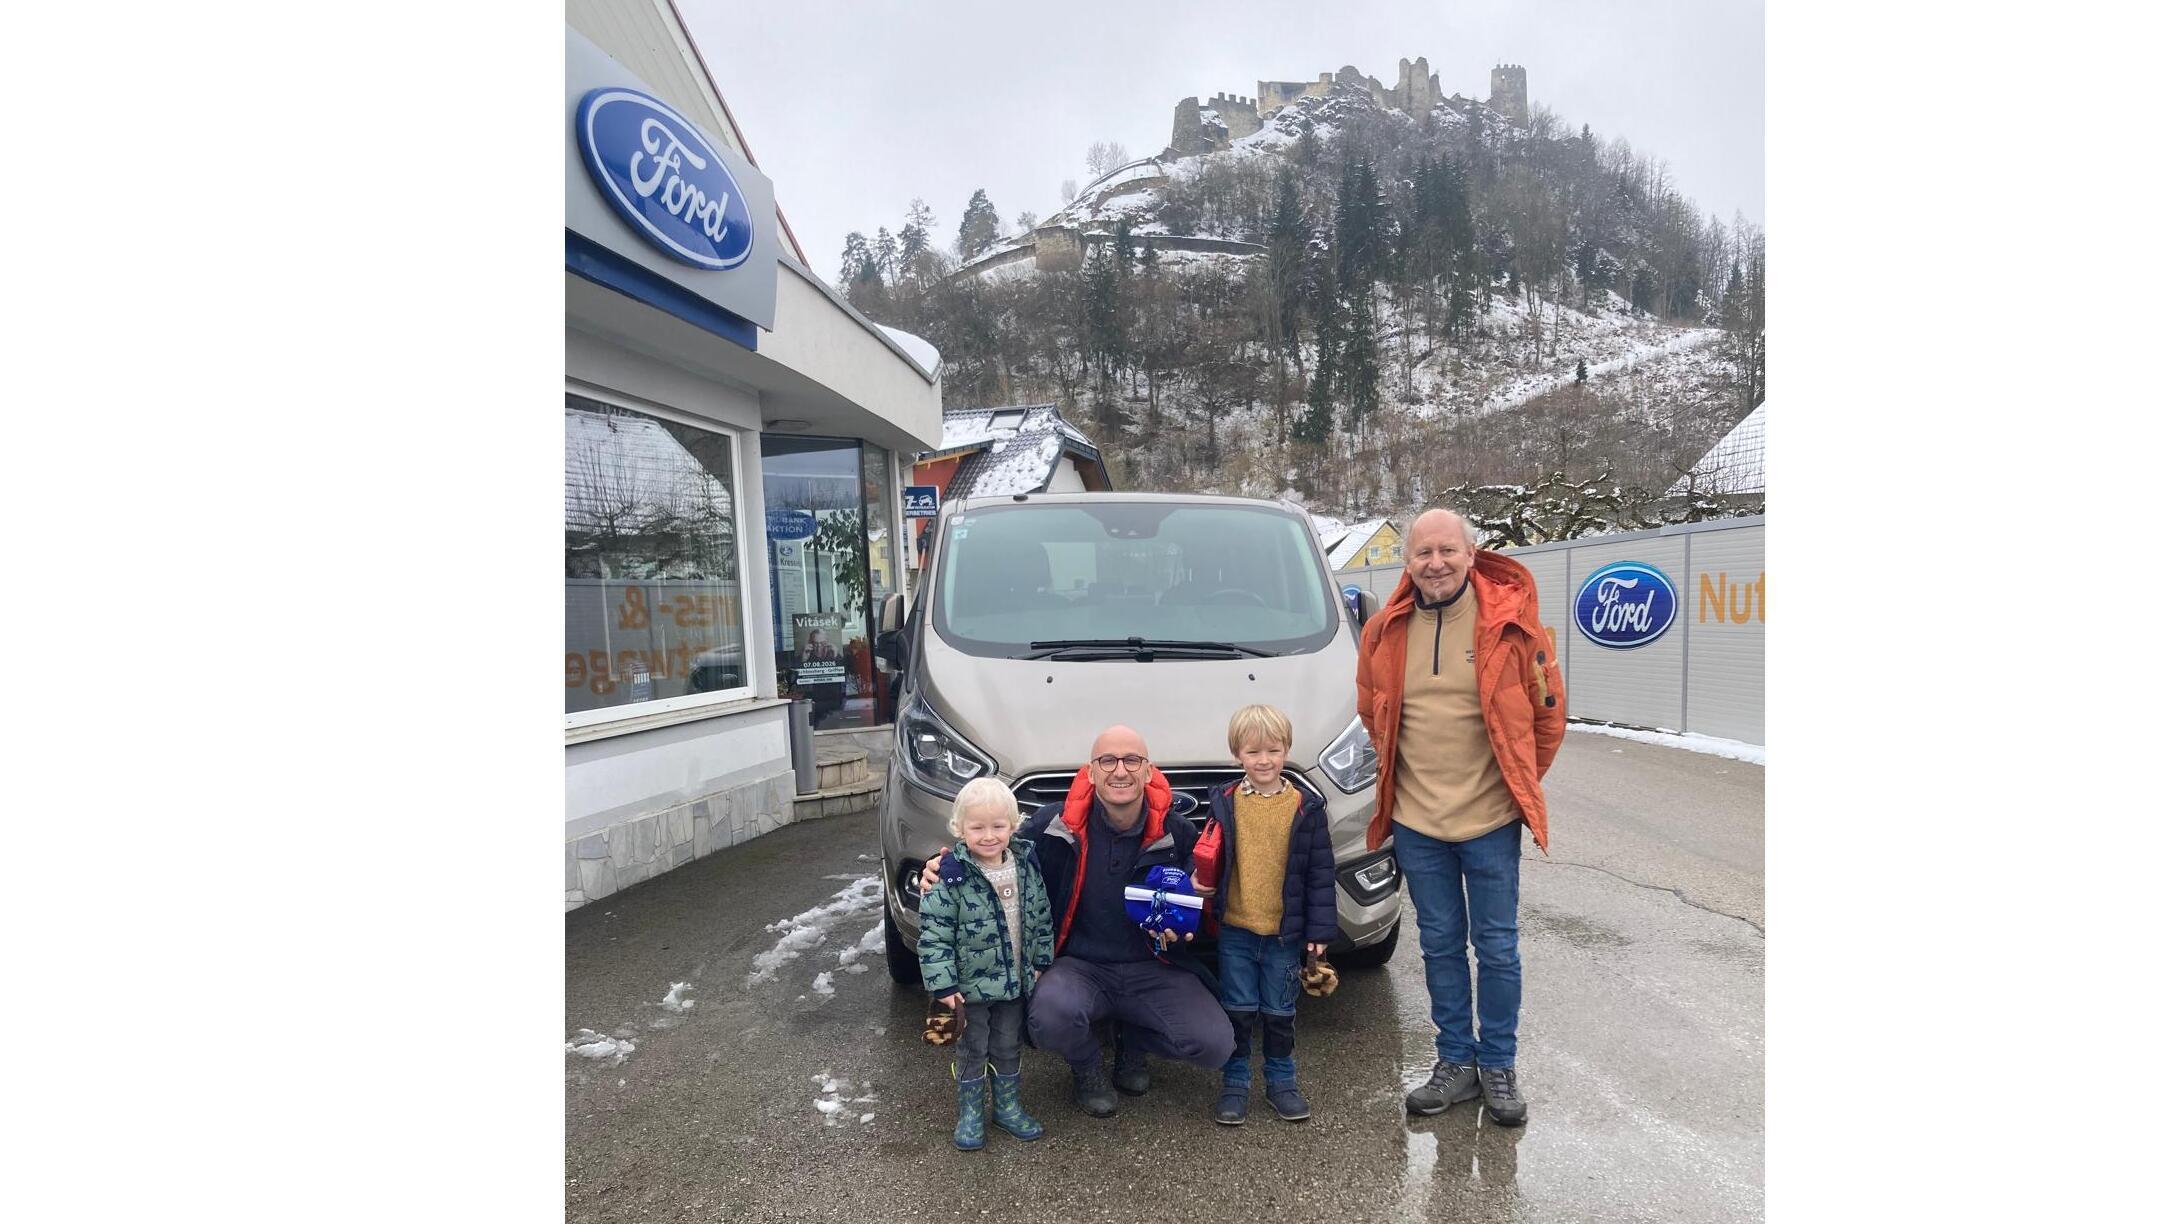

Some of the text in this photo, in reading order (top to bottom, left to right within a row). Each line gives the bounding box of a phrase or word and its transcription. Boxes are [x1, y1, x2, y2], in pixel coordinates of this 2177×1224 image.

[630, 118, 729, 243] Ford
[796, 616, 838, 628] Vitásek
[1592, 577, 1655, 635] Ford
